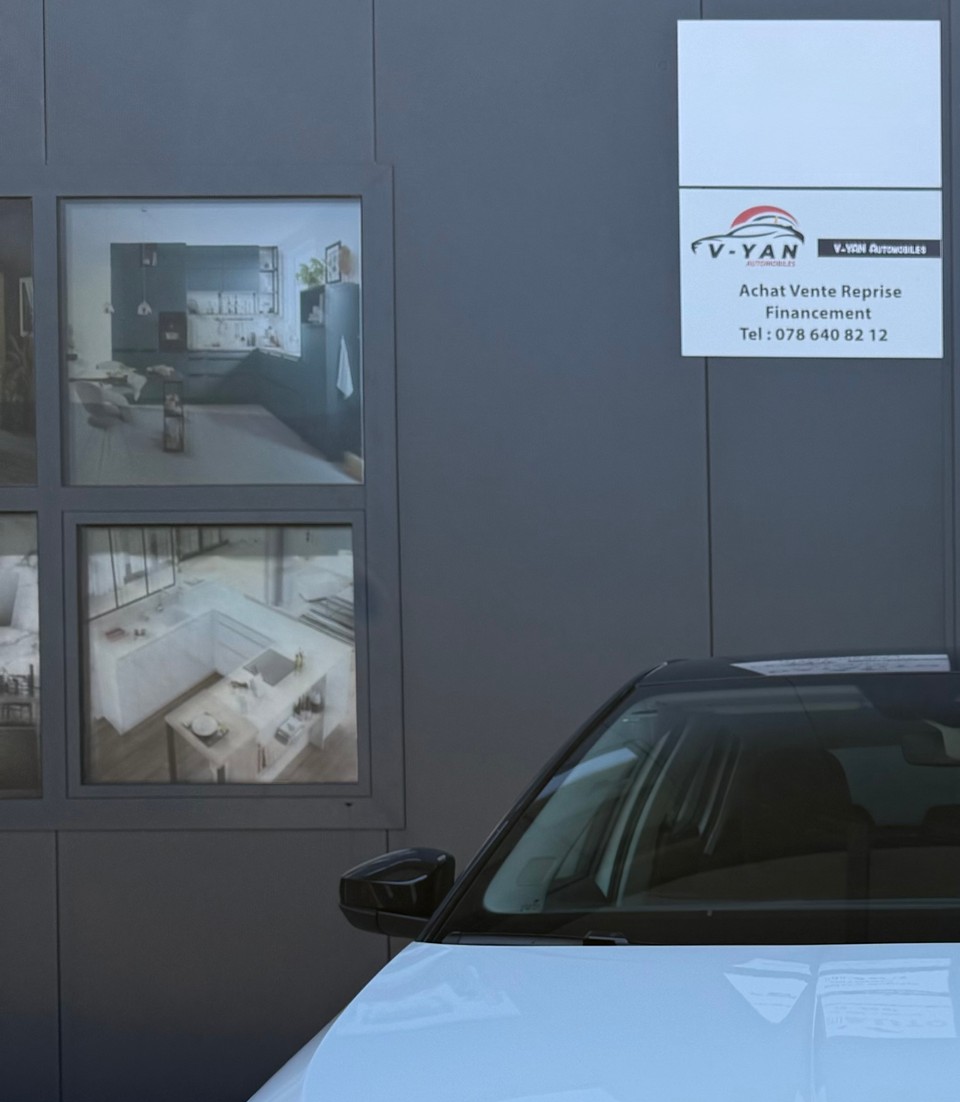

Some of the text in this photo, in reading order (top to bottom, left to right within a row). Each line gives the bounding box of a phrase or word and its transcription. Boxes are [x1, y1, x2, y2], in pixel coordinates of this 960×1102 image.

[708, 243, 799, 259] V-YAN
[833, 243, 867, 253] V-YAN
[745, 260, 796, 268] AUTOMOBILES
[739, 283, 902, 302] Achat Vente Reprise
[765, 305, 872, 320] Financement
[775, 328, 806, 341] 078
[809, 328, 840, 342] 640
[844, 328, 864, 342] 82
[869, 328, 888, 342] 12
